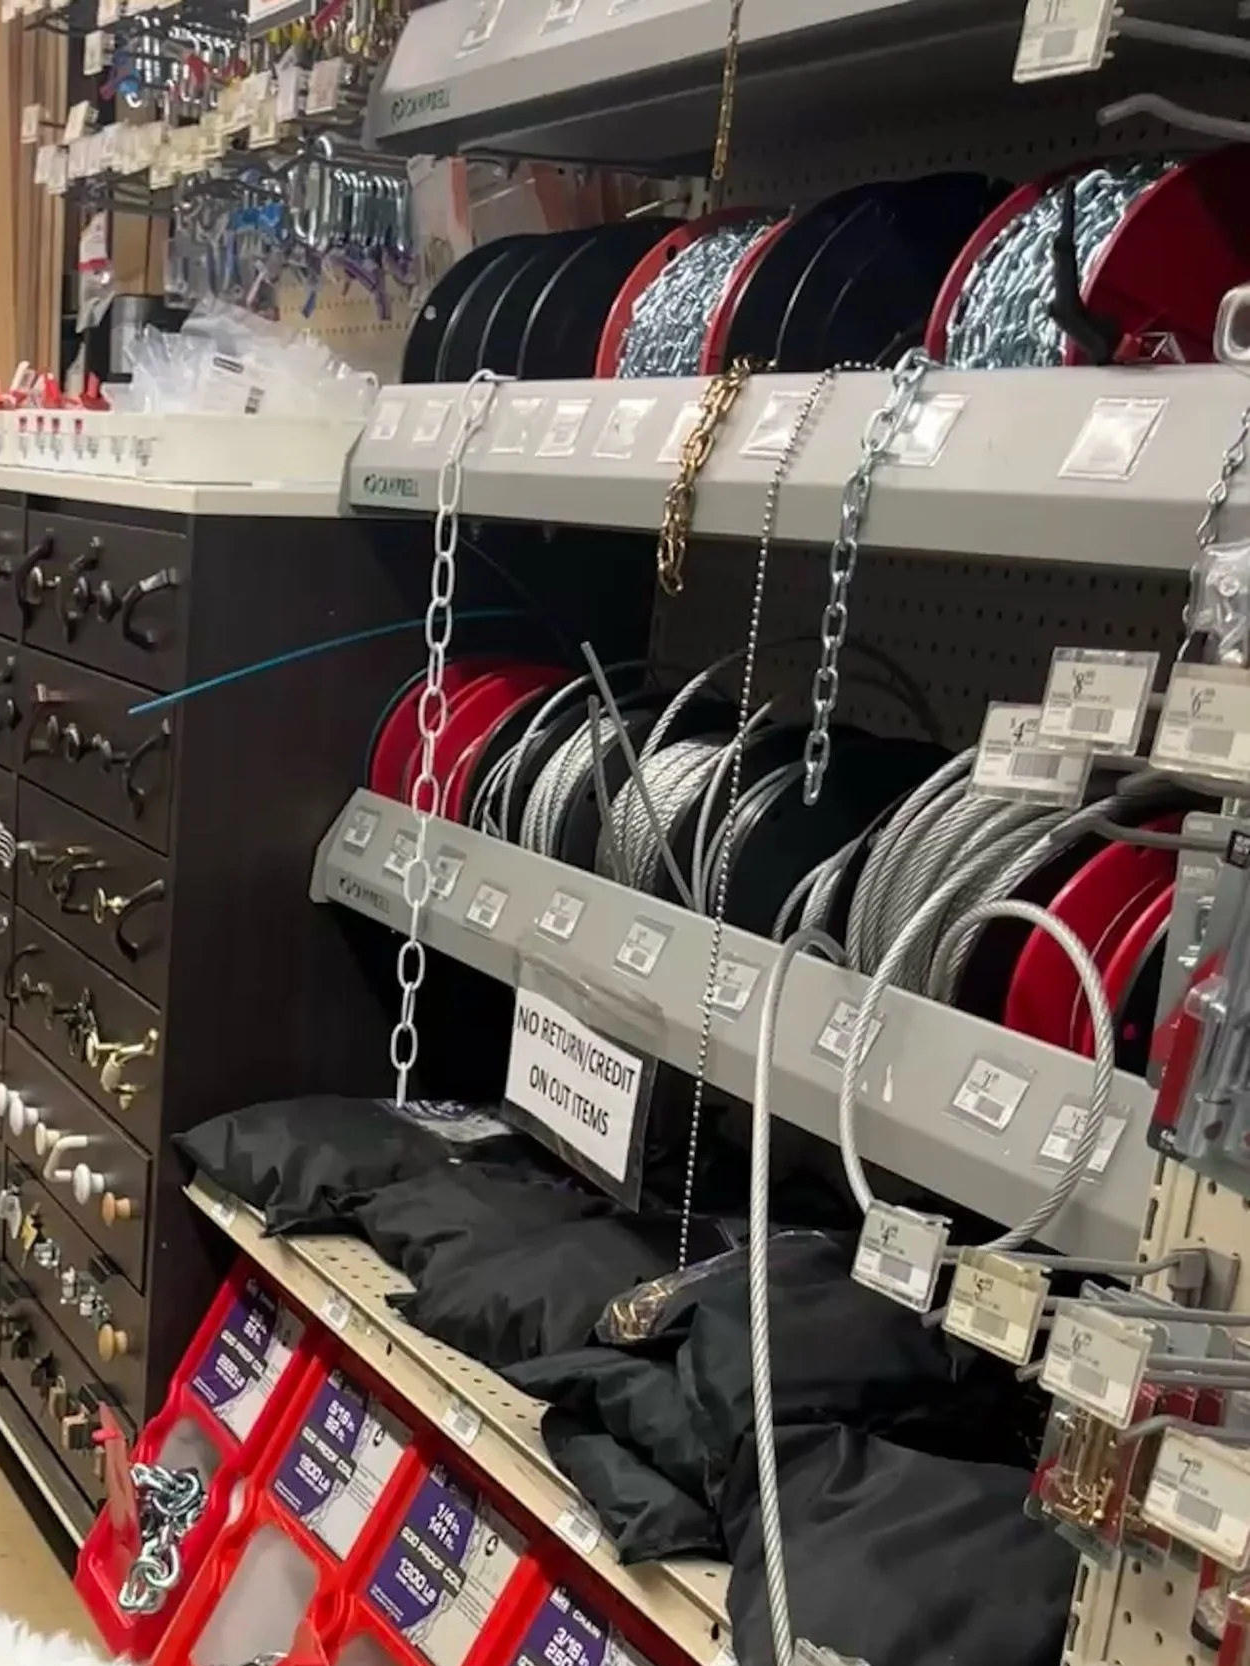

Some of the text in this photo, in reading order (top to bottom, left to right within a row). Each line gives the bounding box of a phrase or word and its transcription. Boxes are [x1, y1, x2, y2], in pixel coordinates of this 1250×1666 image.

[517, 1005, 635, 1094] NO RETURN/CREDIT
[529, 1065, 609, 1136] ON CUT ITEMS
